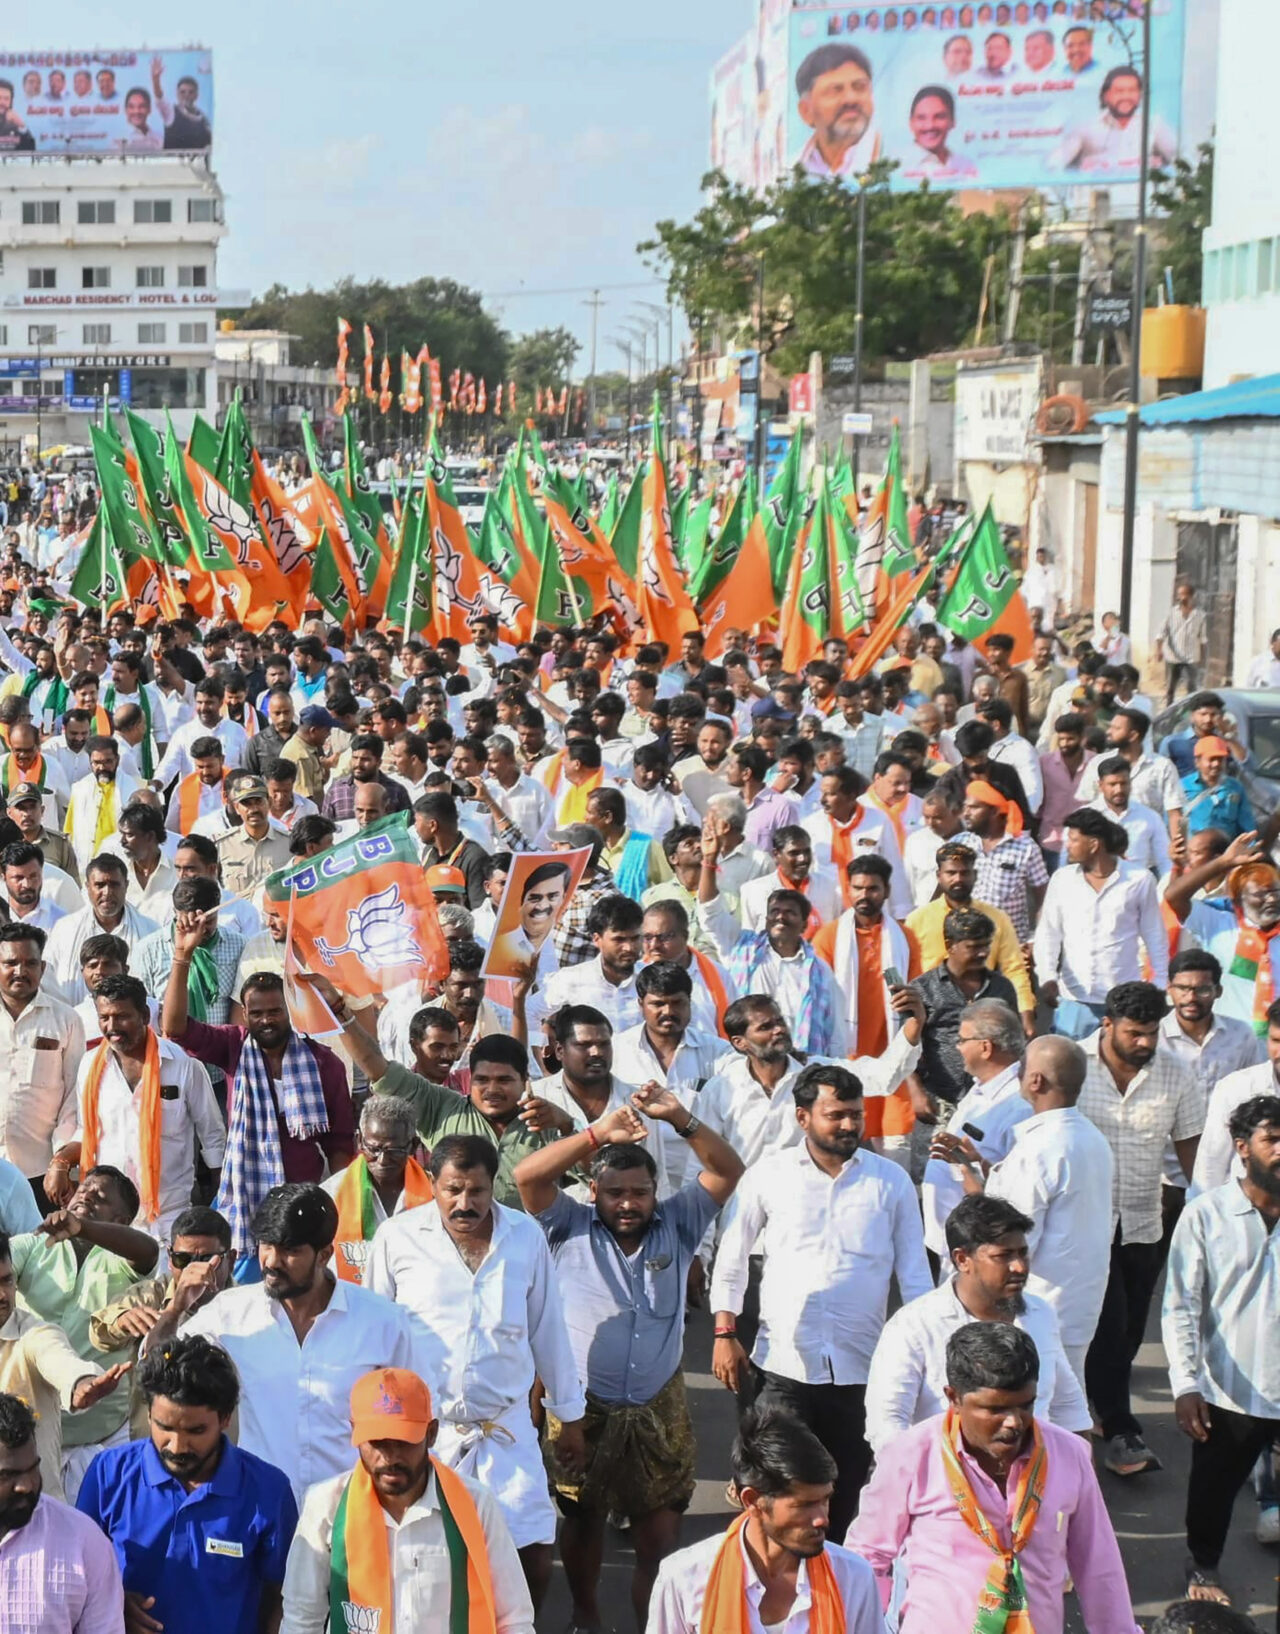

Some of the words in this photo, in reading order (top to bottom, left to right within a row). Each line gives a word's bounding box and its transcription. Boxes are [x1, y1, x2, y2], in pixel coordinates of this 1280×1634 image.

[75, 294, 132, 304] RESIDENCY
[139, 294, 177, 304] HOTEL
[182, 294, 189, 304] &
[76, 356, 167, 366] FURNITURE
[282, 833, 394, 892] BJP
